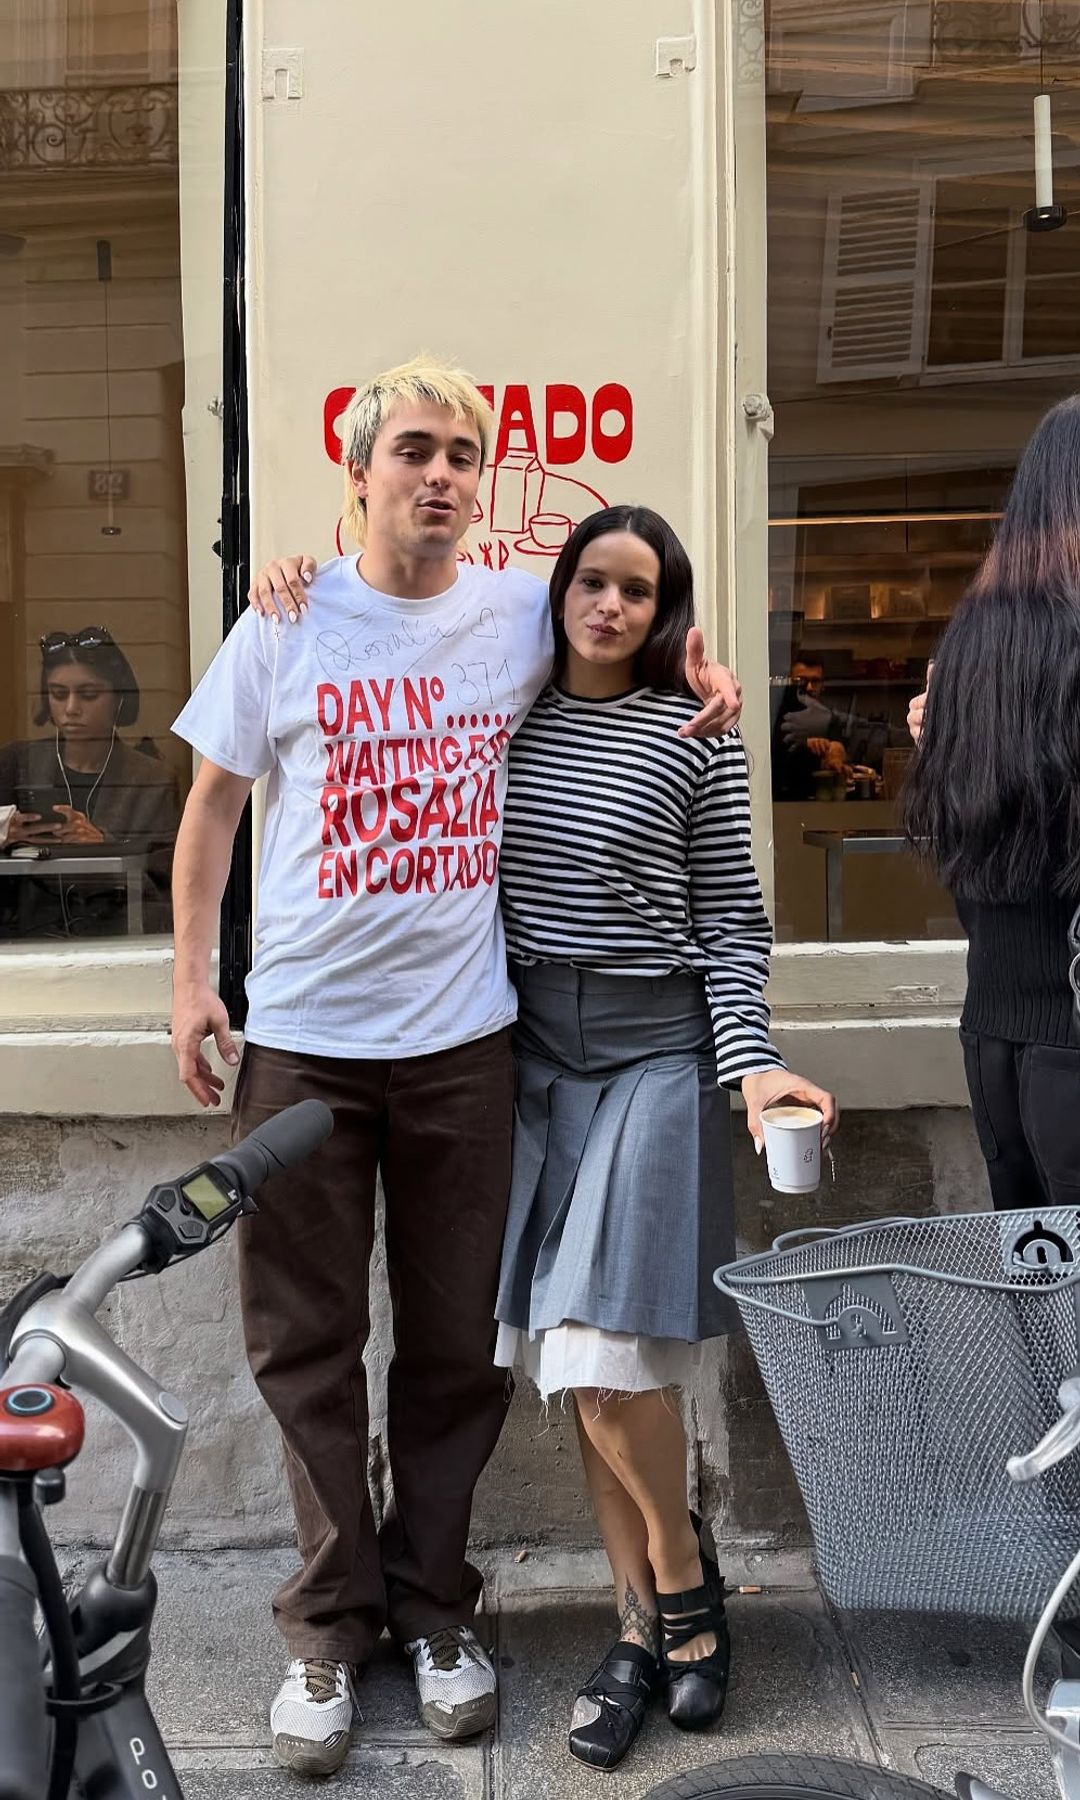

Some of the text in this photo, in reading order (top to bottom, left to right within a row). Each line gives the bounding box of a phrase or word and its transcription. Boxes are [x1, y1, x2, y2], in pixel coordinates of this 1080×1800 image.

[324, 383, 633, 464] CADO
[317, 678, 395, 736] DAY
[451, 659, 521, 705] 371
[325, 736, 462, 786] WAITING
[320, 770, 498, 846] ROSALIA
[317, 840, 498, 898] EN CORTADO
